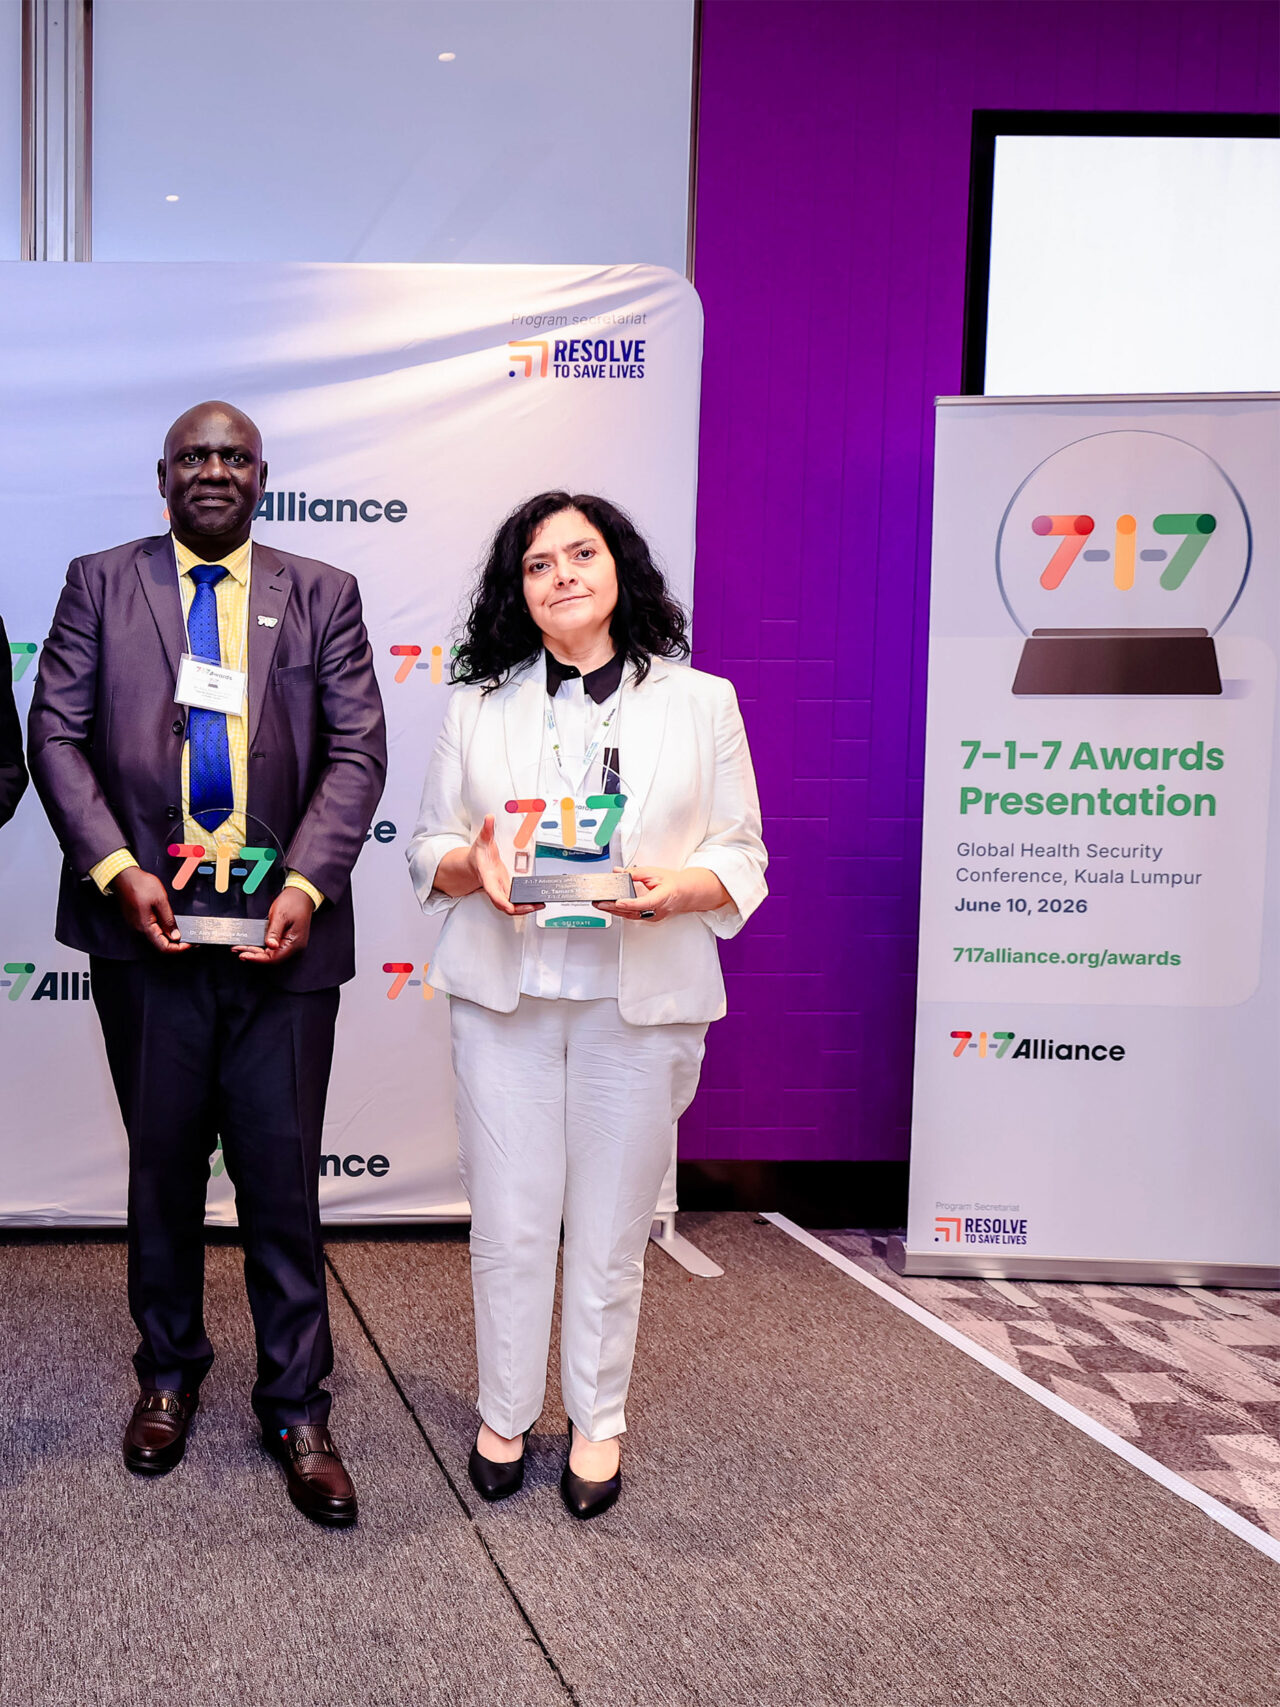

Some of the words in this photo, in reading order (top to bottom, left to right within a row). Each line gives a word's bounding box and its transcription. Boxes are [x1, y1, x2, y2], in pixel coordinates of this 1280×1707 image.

[511, 313, 568, 328] Program
[554, 339, 646, 363] RESOLVE
[554, 364, 570, 379] TO
[573, 364, 606, 378] SAVE
[609, 364, 645, 379] LIVES
[252, 491, 408, 523] Alliance
[1069, 740, 1225, 771] Awards
[959, 784, 1217, 817] Presentation
[957, 842, 1015, 858] Global
[1020, 843, 1081, 858] Health
[1086, 843, 1164, 862] Security
[956, 867, 1068, 885] Conference,
[1074, 869, 1124, 885] Kuala
[1130, 869, 1203, 889] Lumpur
[954, 897, 1001, 913] June
[1006, 898, 1032, 916] 10,
[1037, 898, 1088, 914] 2026
[953, 947, 1182, 968] 717alliance.org/awards
[1012, 1039, 1126, 1061] Alliance
[935, 1201, 972, 1212] Program
[974, 1202, 1020, 1212] Secretariat
[965, 1218, 1028, 1234] RESOLVE
[965, 1234, 977, 1243] TO
[978, 1234, 1001, 1244] SAVE
[1002, 1235, 1028, 1245] LIVES
